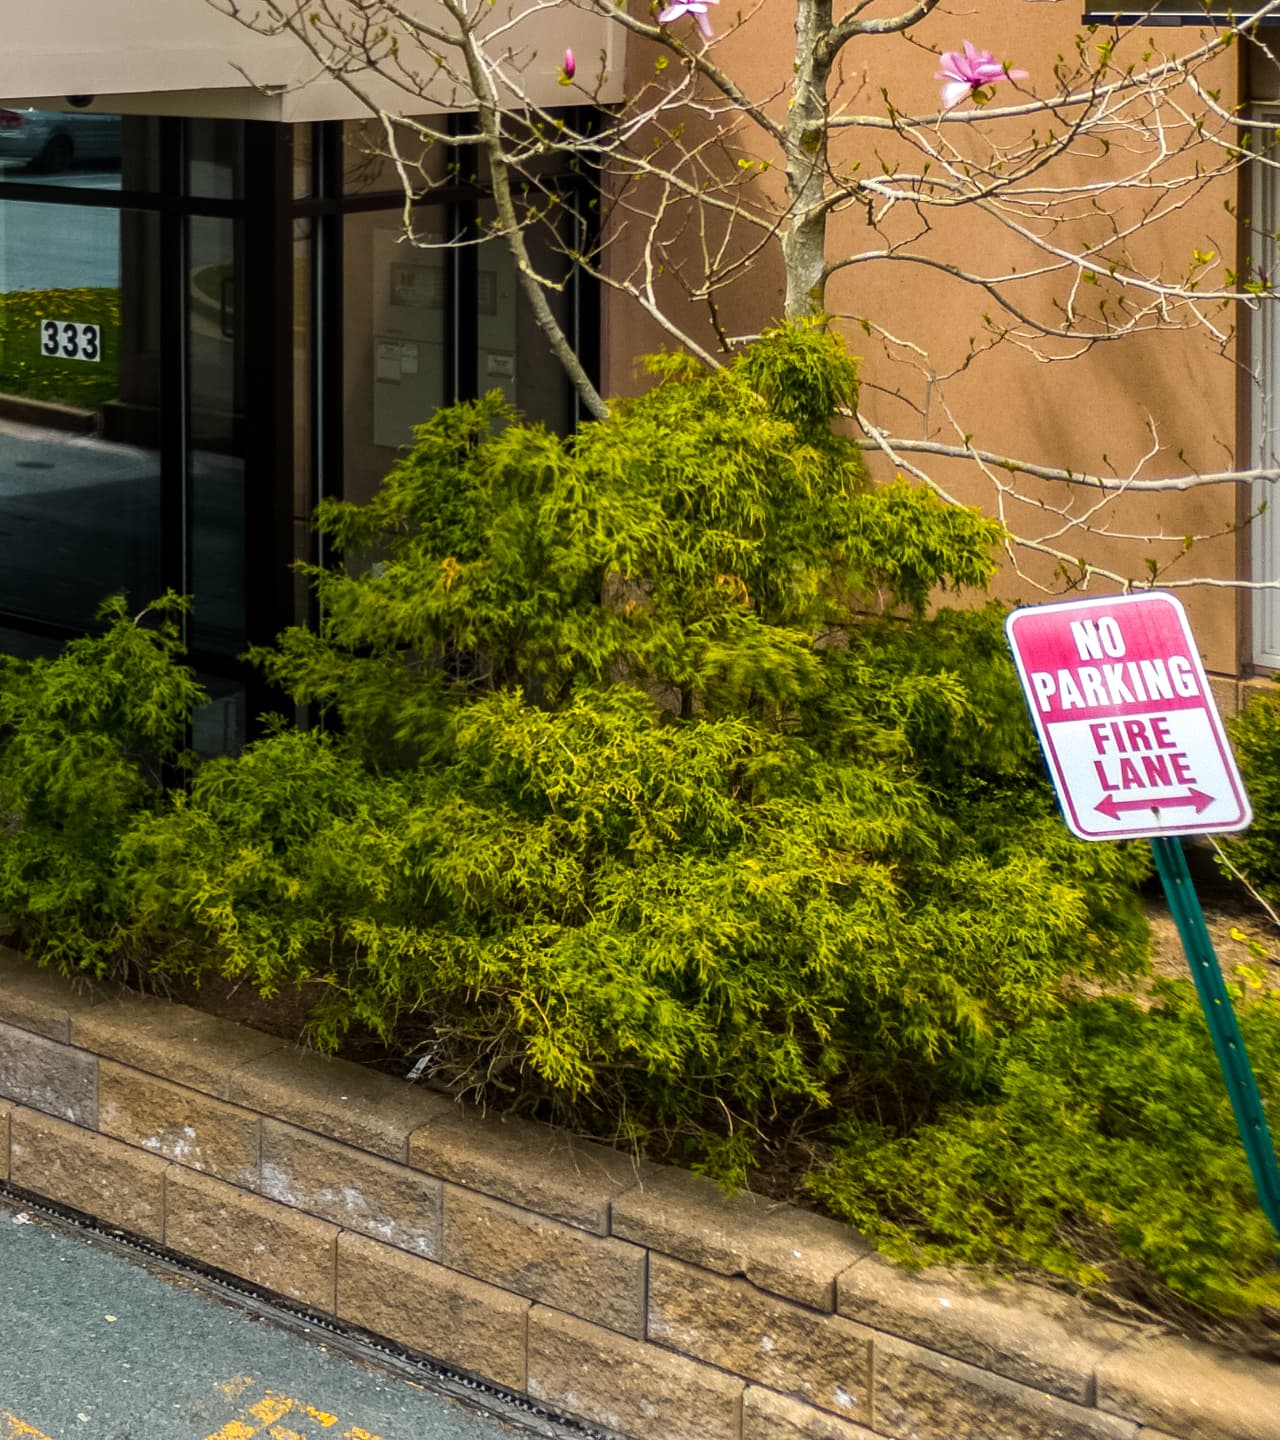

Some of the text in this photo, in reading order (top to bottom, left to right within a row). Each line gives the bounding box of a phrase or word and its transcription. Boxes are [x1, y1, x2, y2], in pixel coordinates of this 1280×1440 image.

[44, 321, 98, 360] 333
[1070, 616, 1127, 661] NO
[1031, 655, 1201, 712] PARKING
[1089, 716, 1177, 755] FIRE
[1093, 752, 1198, 792] LANE
